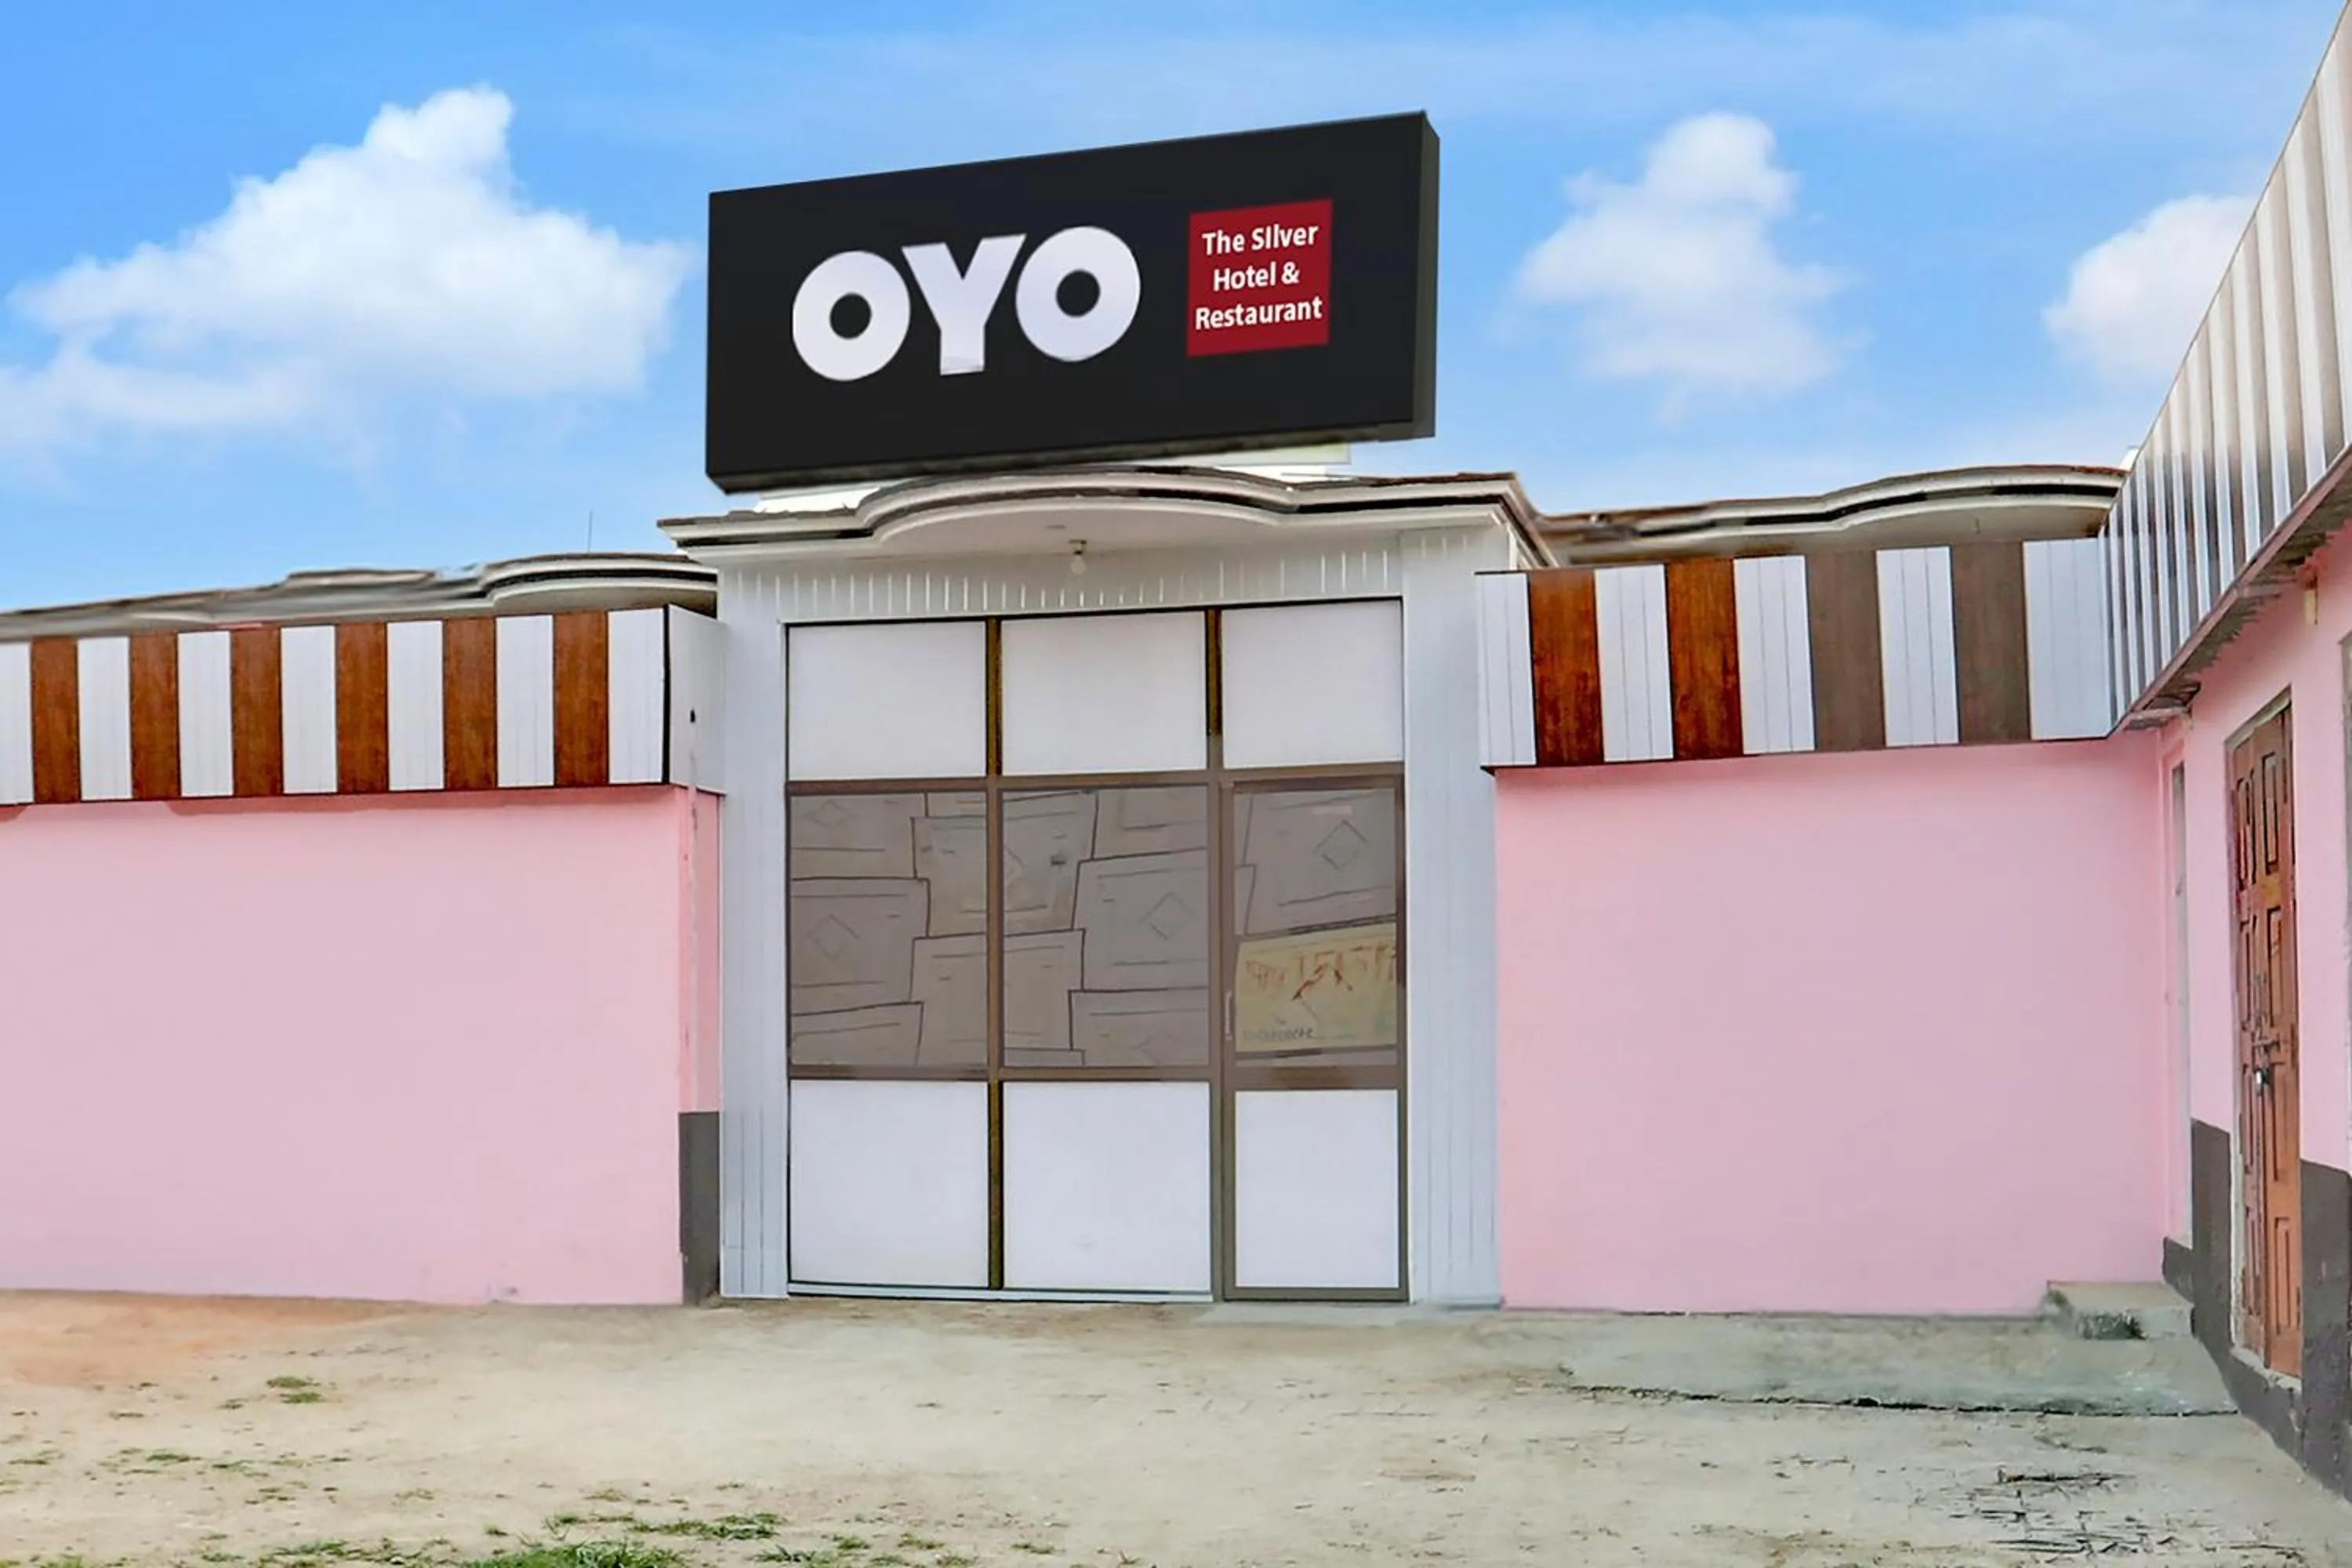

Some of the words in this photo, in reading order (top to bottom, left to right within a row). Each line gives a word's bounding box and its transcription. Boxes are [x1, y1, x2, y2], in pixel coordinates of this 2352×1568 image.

[1201, 228, 1245, 256] The
[1213, 261, 1276, 292] Hotel
[1281, 261, 1300, 285] &
[792, 226, 1141, 381] OYO
[1195, 295, 1323, 330] Restaurant
